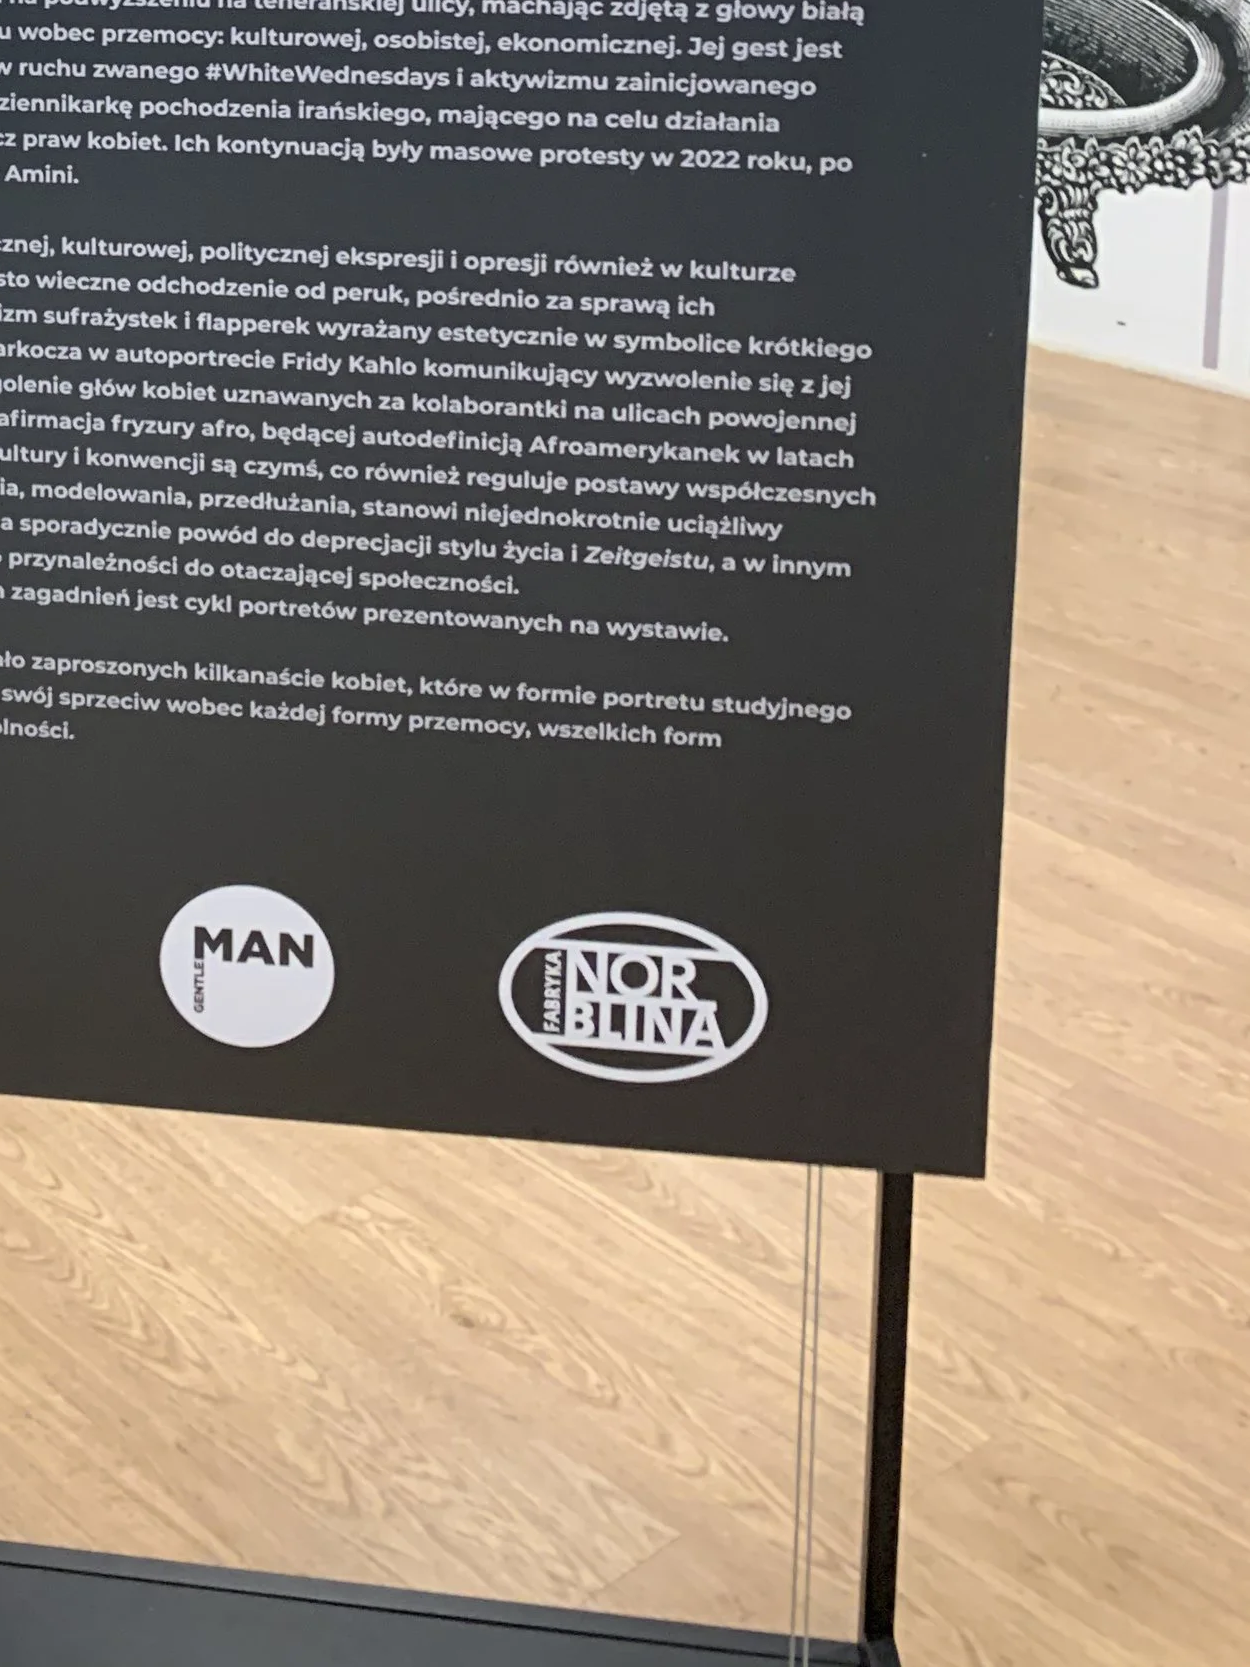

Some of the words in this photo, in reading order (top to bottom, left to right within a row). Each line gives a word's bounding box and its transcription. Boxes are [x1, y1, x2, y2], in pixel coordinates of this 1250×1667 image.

[18, 57, 87, 78] ruchu
[92, 63, 200, 85] zwanego
[456, 66, 464, 88] i
[469, 68, 609, 93] aktywizmu
[614, 71, 817, 101] zainicjowanego
[139, 97, 292, 120] pochodzenia
[297, 99, 432, 127] irańskiego,
[437, 103, 562, 131] mającego
[567, 111, 599, 128] na
[604, 109, 659, 130] celu
[664, 109, 781, 133] działania
[3, 163, 80, 185] Amini.
[61, 235, 195, 264] kulturowej,
[199, 241, 330, 269] politycznej
[335, 246, 445, 274] ekspresji
[450, 249, 458, 270] i
[463, 252, 548, 278] opresji
[554, 254, 654, 278] również
[659, 262, 684, 278] w
[689, 259, 797, 283] kulturze
[34, 269, 132, 293] wieczne
[136, 274, 290, 299] odchodzenie
[294, 280, 326, 301] od
[332, 283, 411, 307] peruk,
[416, 286, 541, 309] pośrednio
[545, 294, 574, 311] za
[579, 296, 671, 320] sprawą
[677, 294, 716, 317] ich
[110, 413, 196, 440] fryzury
[200, 418, 256, 443] afro,
[261, 420, 356, 449] będącej
[361, 429, 523, 458] autodefinicją
[528, 434, 741, 464] Afroamerykanek
[746, 449, 771, 465] w
[776, 445, 855, 469] latach
[30, 481, 193, 510] modelowania,
[198, 491, 357, 519] przedłużania,
[362, 499, 458, 521] stanowi
[464, 501, 661, 532] niejednokrotnie
[667, 513, 784, 542] uciążliwy
[1, 685, 54, 709] swój
[58, 691, 161, 712] sprzeciw
[165, 696, 244, 718] wobec
[249, 699, 326, 727] każdej
[331, 705, 403, 732] formy
[408, 714, 532, 740] przemocy,
[537, 721, 657, 744] wszelkich
[663, 725, 722, 748] form
[193, 925, 315, 969] MAN
[193, 959, 205, 1014] GENTLE
[542, 949, 565, 1034] FABRYKA
